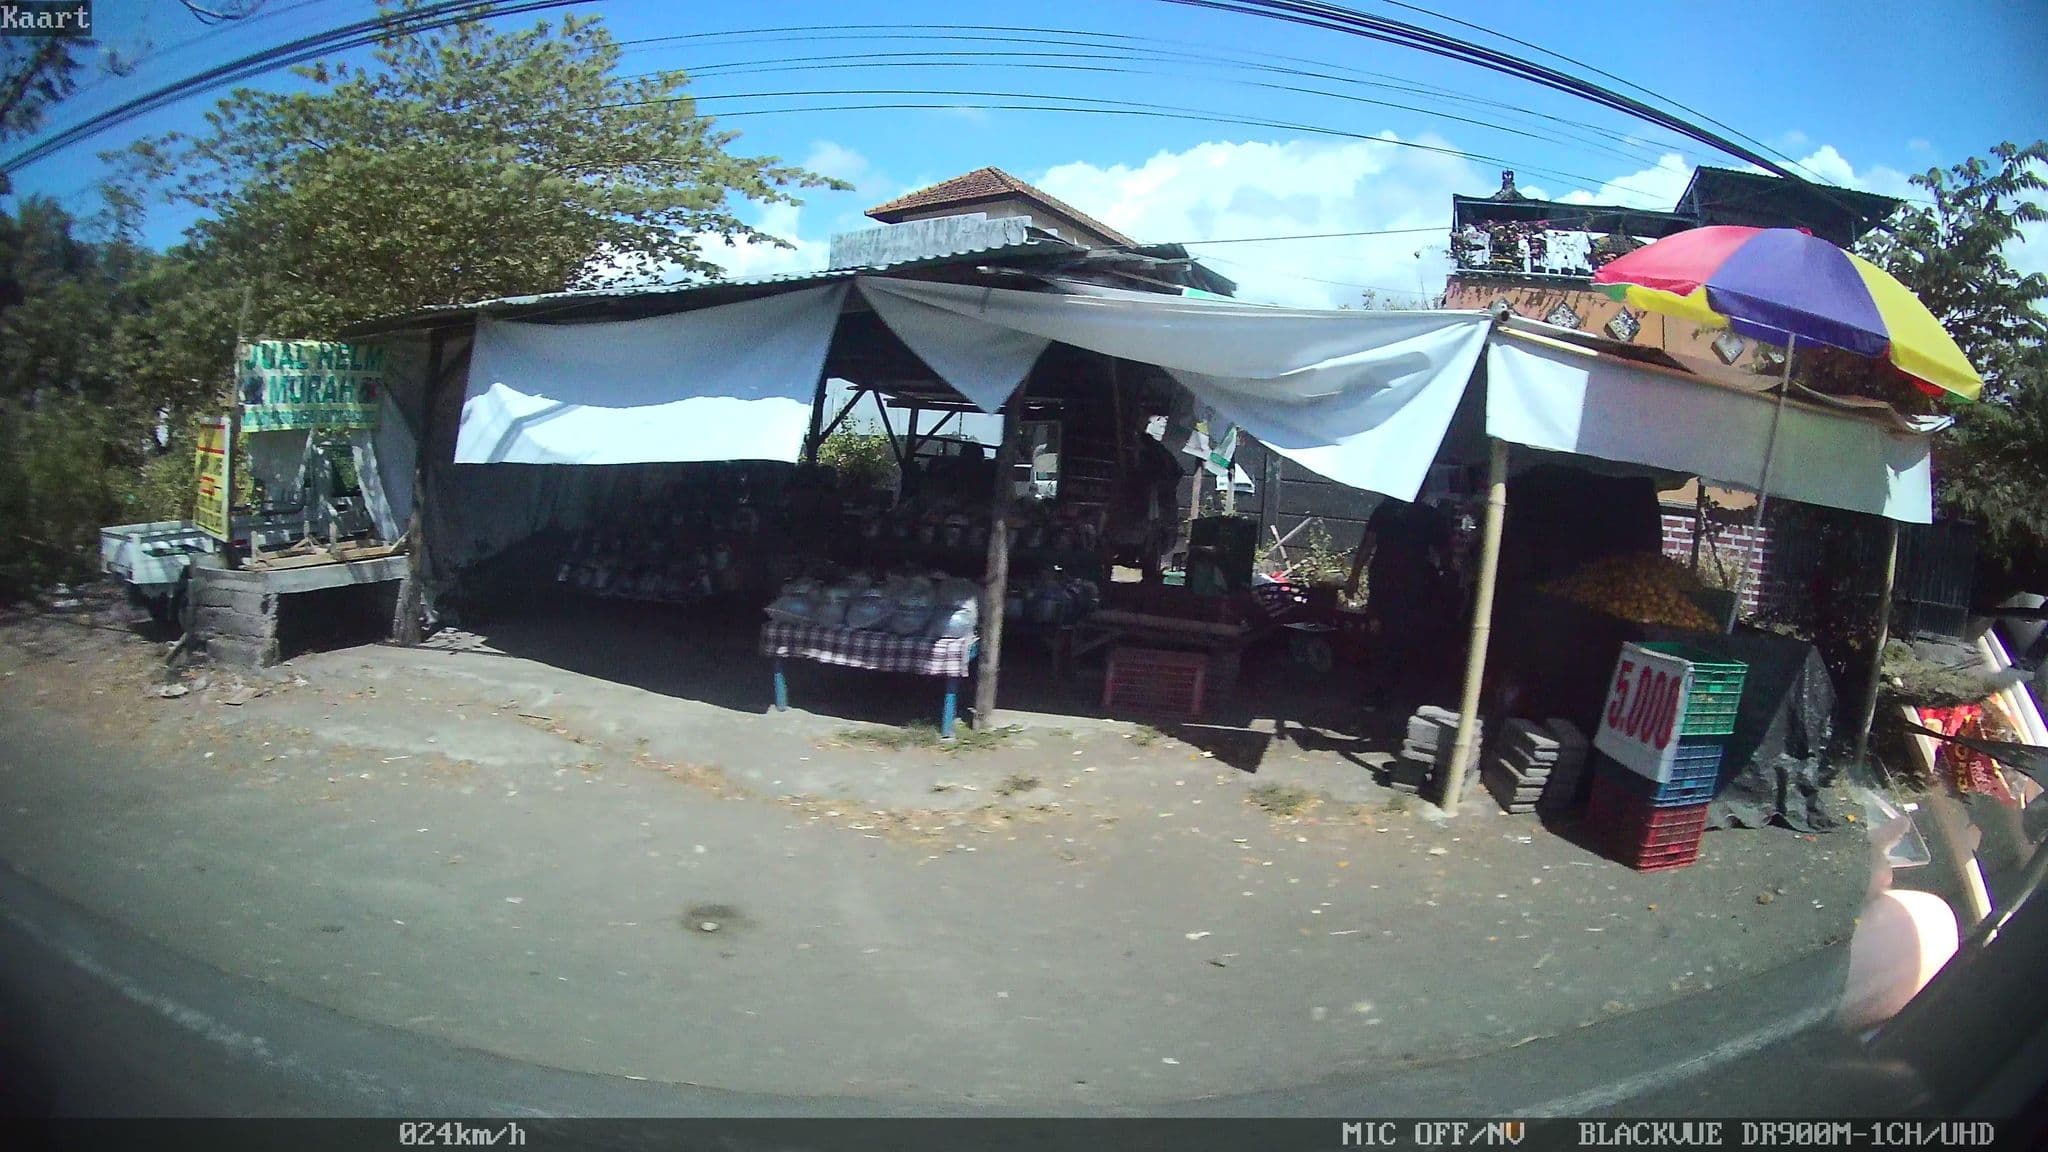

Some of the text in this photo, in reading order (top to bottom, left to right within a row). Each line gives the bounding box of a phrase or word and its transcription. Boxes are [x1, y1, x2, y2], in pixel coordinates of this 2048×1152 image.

[244, 340, 384, 371] JUAL HELM
[269, 374, 356, 404] MURAH
[1607, 660, 1682, 750] 5.000
